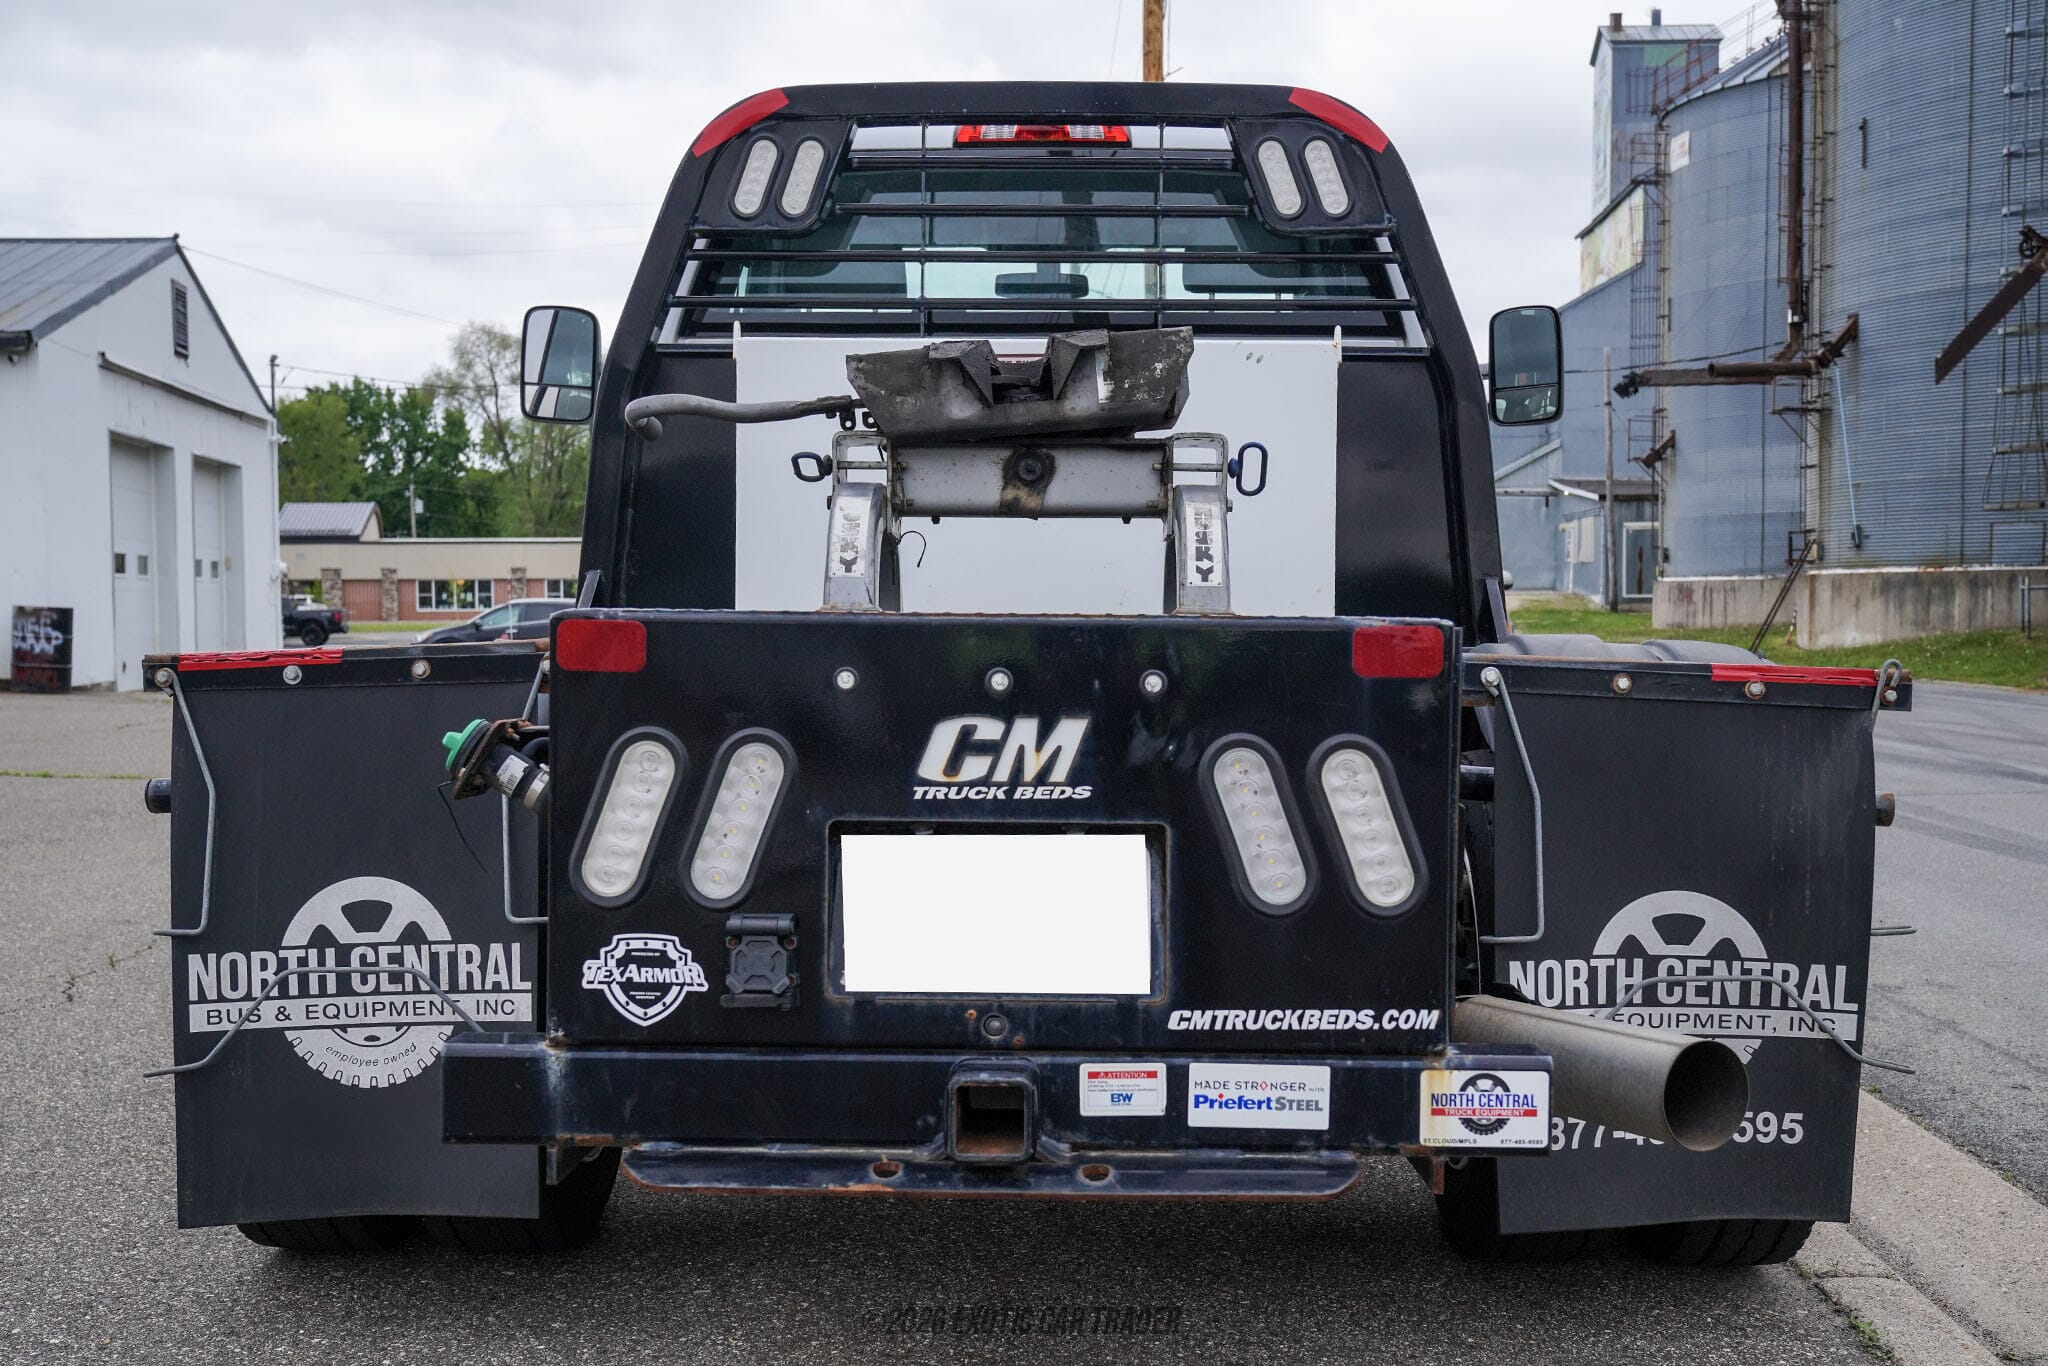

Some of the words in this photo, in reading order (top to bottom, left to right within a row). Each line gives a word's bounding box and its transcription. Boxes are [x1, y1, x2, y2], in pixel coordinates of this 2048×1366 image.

[917, 716, 1089, 783] CM
[913, 786, 1009, 800] TRUCK
[1013, 786, 1093, 800] BEDS
[188, 948, 338, 1001] NORTH
[350, 942, 532, 994] CENTRAL
[1508, 957, 1644, 1008] NORTH
[1657, 957, 1859, 1012] CENTRAL
[206, 1007, 262, 1026] BUS
[274, 1005, 293, 1022] &
[476, 998, 516, 1016] INC
[1167, 1008, 1440, 1032] CMTRUCKBEDS.COM
[325, 1046, 380, 1068] employee
[383, 1042, 417, 1065] owned
[1108, 1071, 1148, 1080] ATTENTION
[1194, 1080, 1231, 1091] MADE
[1193, 1092, 1274, 1112] Priefert
[1274, 1096, 1324, 1112] STEEL
[1431, 1093, 1475, 1108] NORTH
[1478, 1094, 1538, 1108] CENTRAL
[1444, 1108, 1475, 1116] TRUCK
[1475, 1109, 1525, 1117] EQUIPMENT
